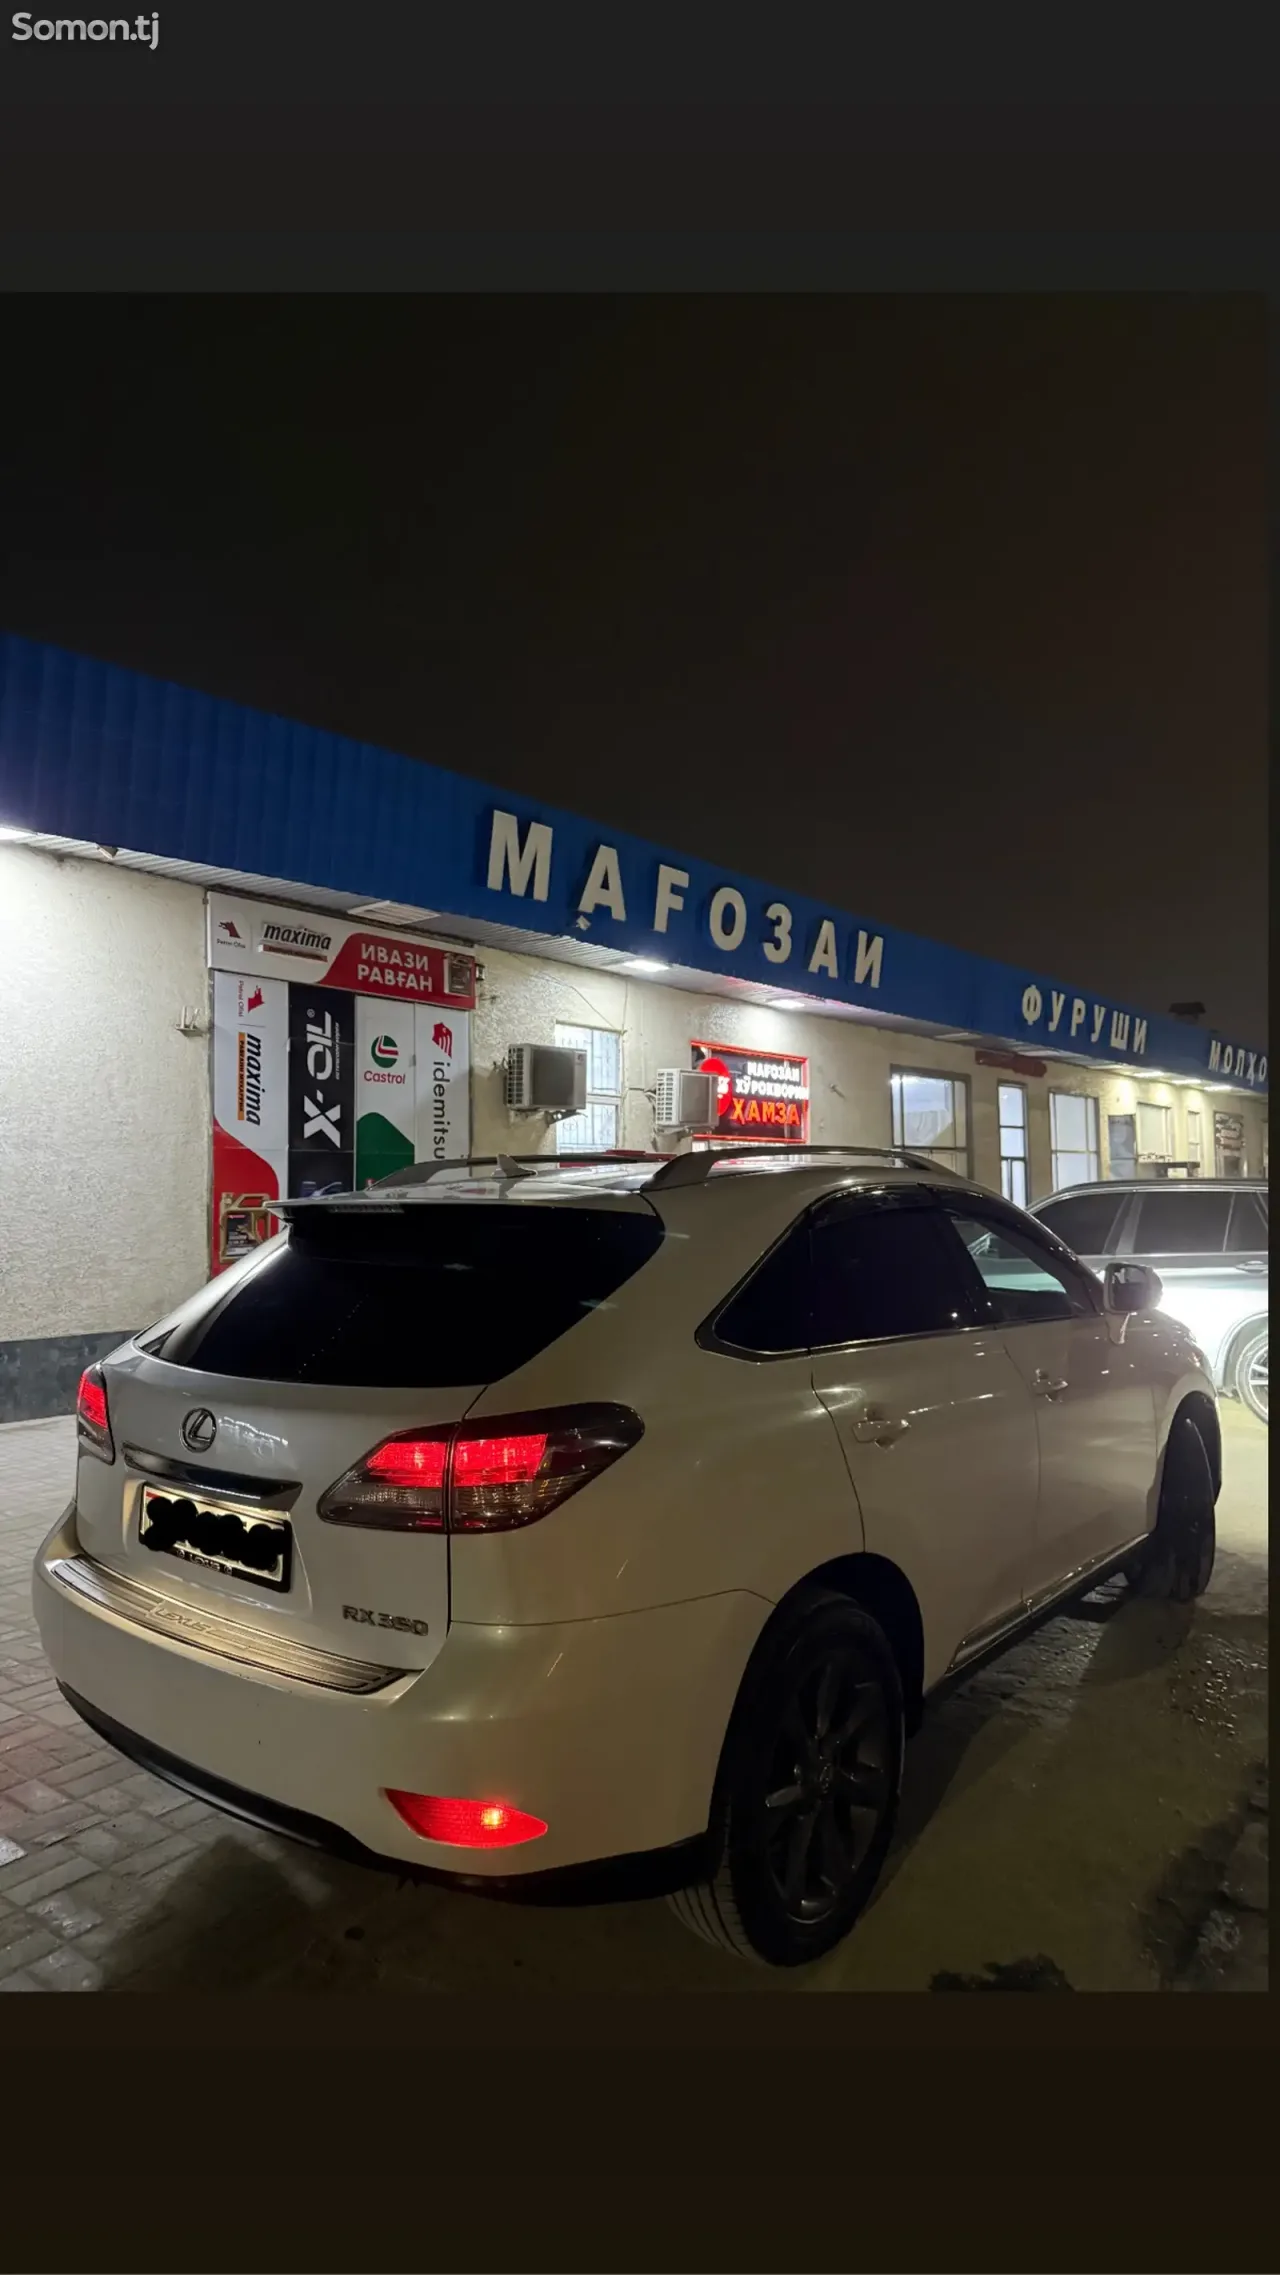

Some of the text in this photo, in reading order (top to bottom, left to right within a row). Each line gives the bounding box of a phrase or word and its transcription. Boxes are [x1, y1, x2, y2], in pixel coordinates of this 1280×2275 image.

[263, 924, 332, 950] maxima
[361, 943, 429, 972] ИВАЗИ
[357, 963, 433, 992] РАВҒАН
[1021, 984, 1148, 1055] ФУРУШИ
[246, 1033, 266, 1127] maxima
[363, 1070, 406, 1084] Castrol
[433, 1061, 451, 1160] idemitsu
[154, 1608, 212, 1632] LEXUS
